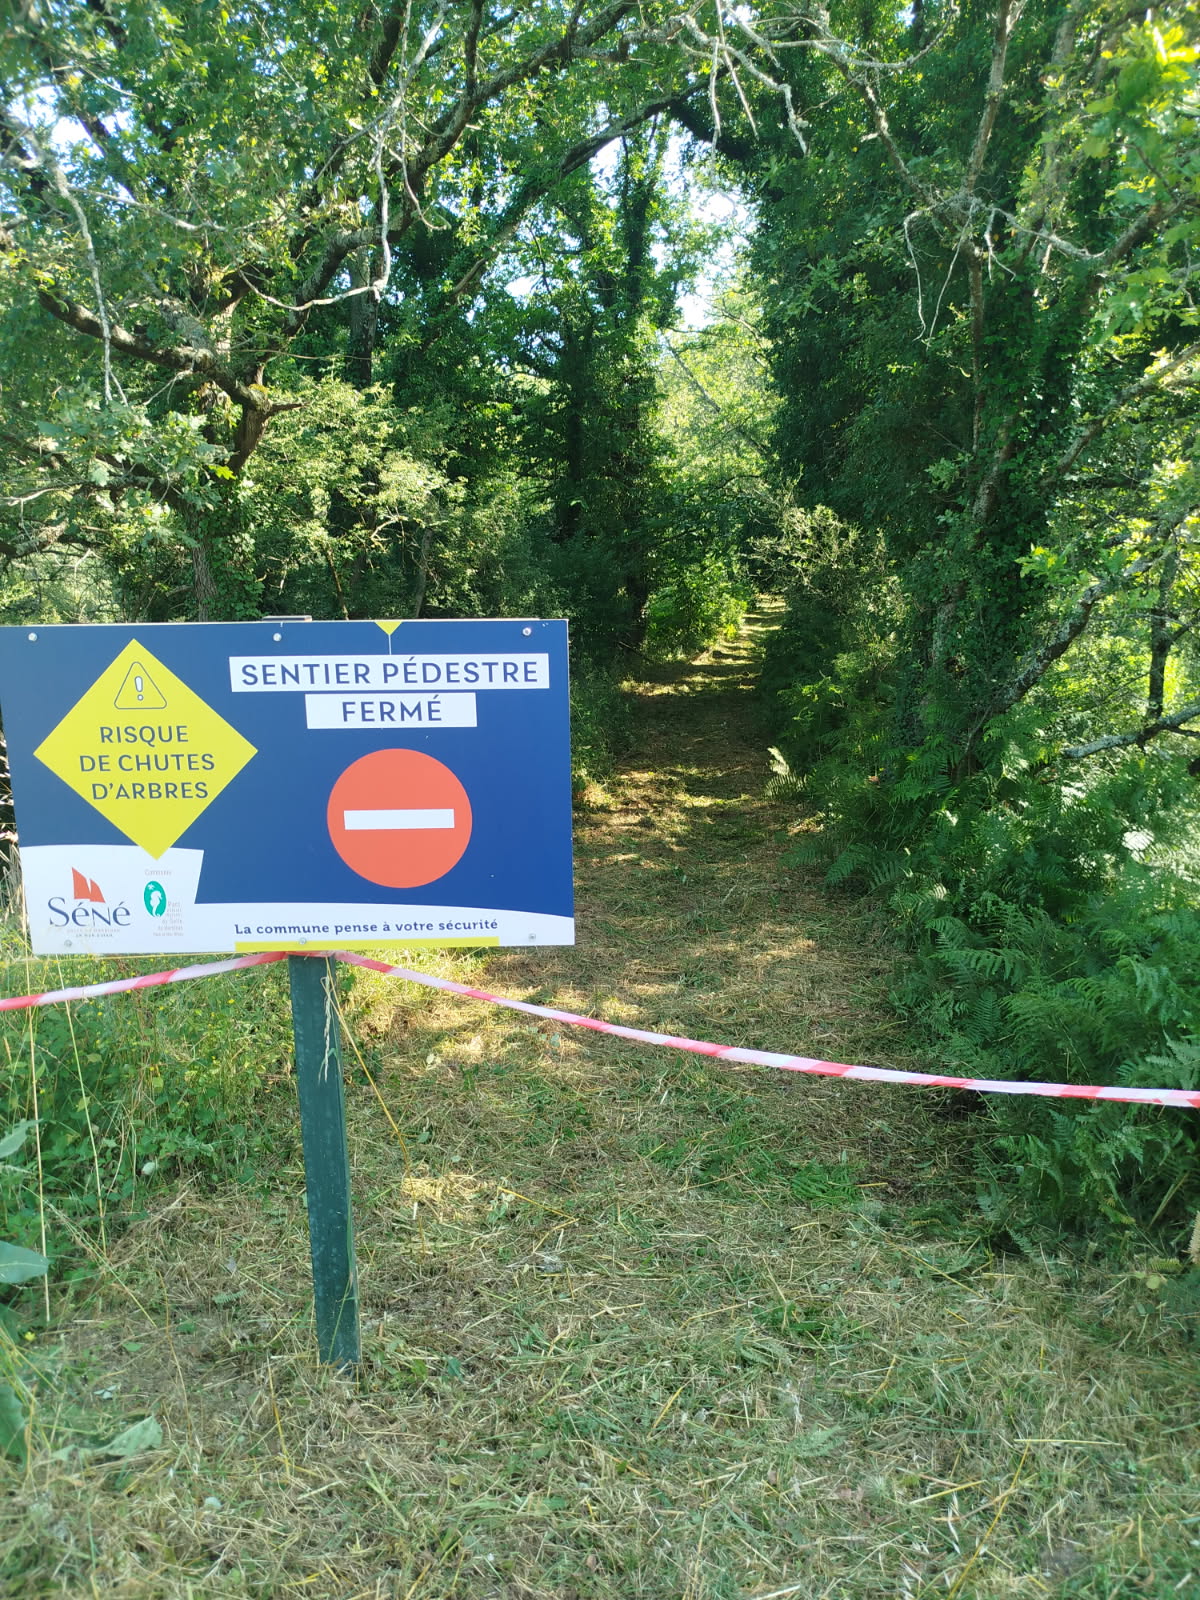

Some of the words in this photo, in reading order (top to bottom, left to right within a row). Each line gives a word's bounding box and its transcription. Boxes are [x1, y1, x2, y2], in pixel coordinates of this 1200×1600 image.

[241, 662, 371, 686] SENTIER
[382, 656, 539, 684] PÉDESTRE
[341, 694, 442, 723] FERMÉ
[99, 725, 189, 748] RISQUE
[79, 754, 111, 772] DE
[117, 753, 216, 772] CHUTES
[91, 781, 209, 800] D’ARBRES
[234, 923, 252, 935] La
[256, 924, 330, 935] commune
[334, 922, 378, 936] pense
[382, 920, 391, 932] à
[395, 920, 434, 932] votre
[438, 918, 499, 931] sécurité
